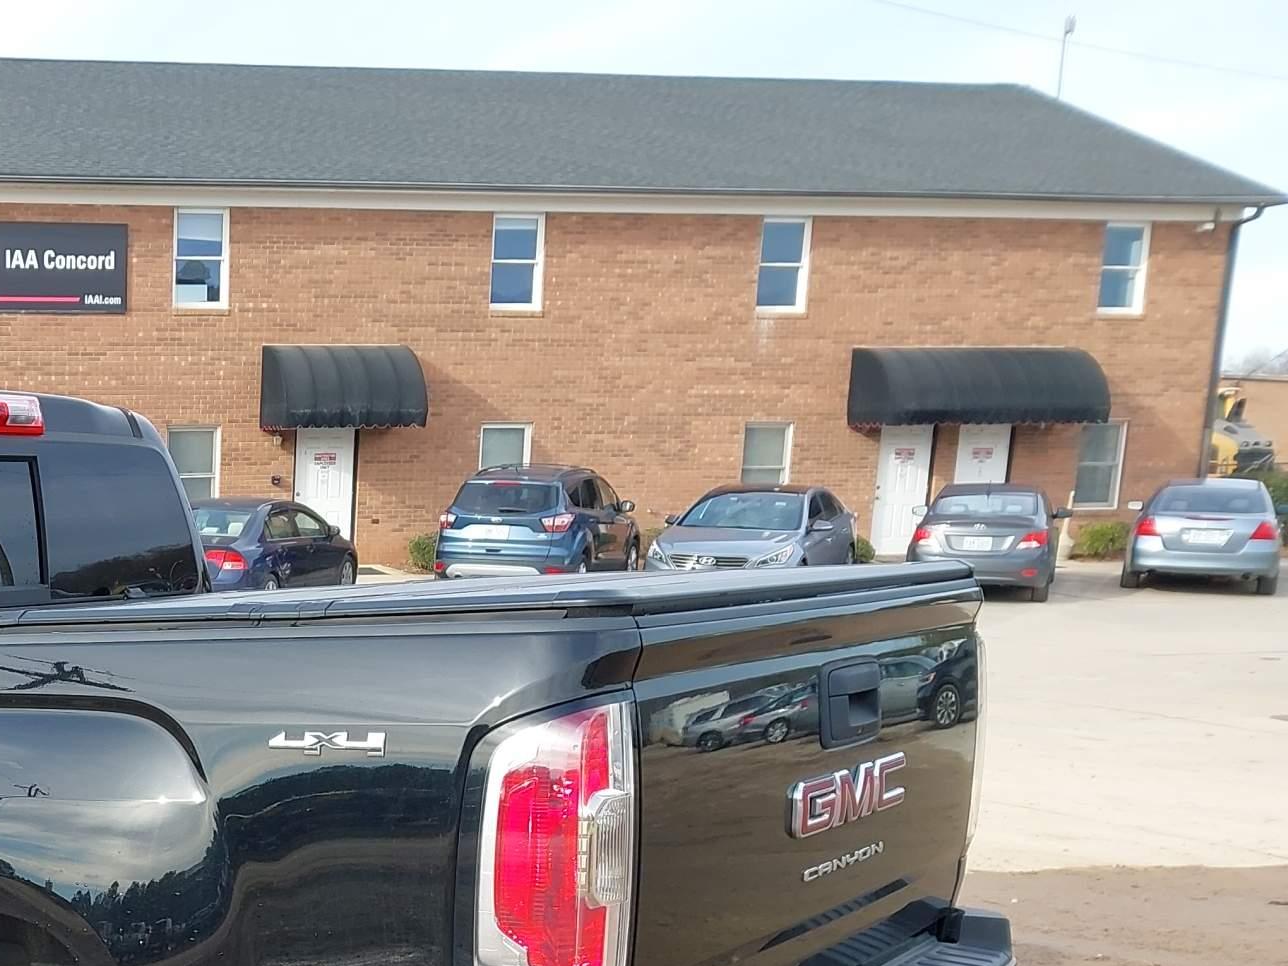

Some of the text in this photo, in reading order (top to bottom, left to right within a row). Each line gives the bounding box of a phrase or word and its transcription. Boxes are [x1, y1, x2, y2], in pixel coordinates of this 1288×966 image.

[5, 249, 116, 271] IAA Concord
[84, 294, 122, 305] IAAI.com
[787, 751, 906, 839] GMC
[802, 840, 884, 882] CANYON
